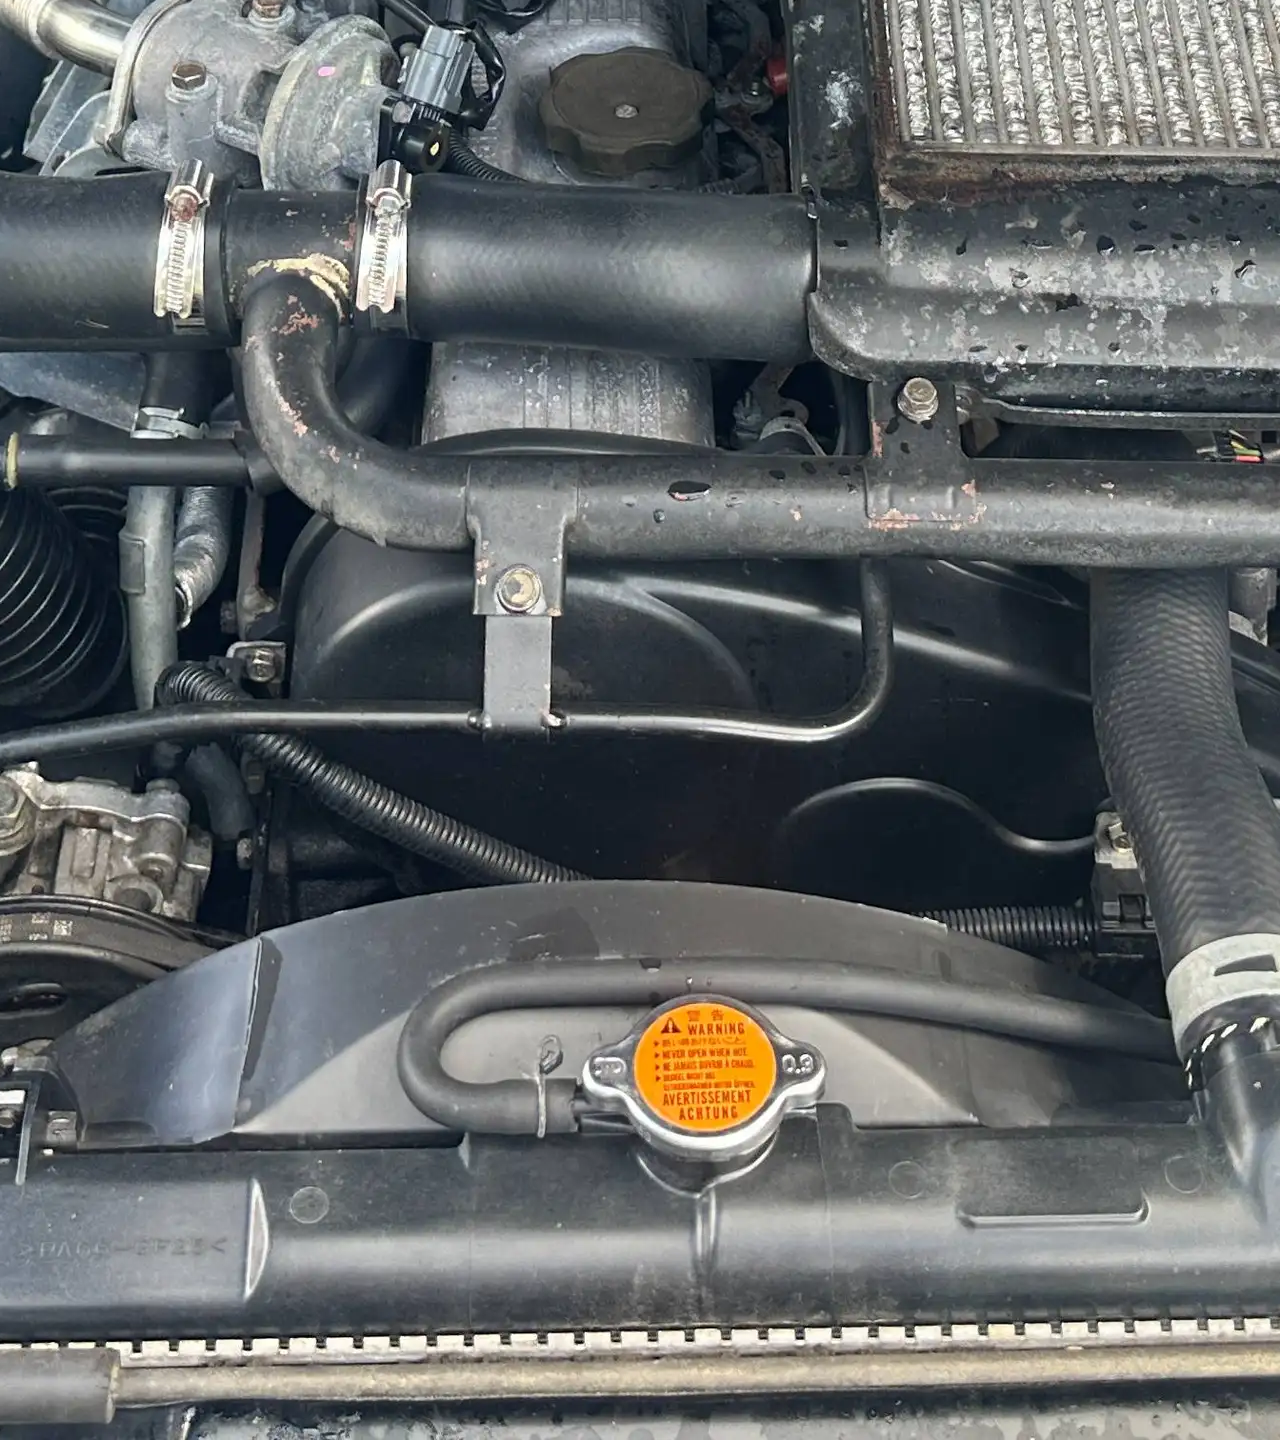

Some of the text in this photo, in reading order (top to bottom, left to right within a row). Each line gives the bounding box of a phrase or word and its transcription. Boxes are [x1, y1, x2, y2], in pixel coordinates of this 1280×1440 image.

[687, 1022, 745, 1035] WARNING
[688, 1049, 707, 1058] OPEN
[663, 1089, 752, 1106] AVERTISSEMENT
[678, 1105, 738, 1121] ACHTUNG
